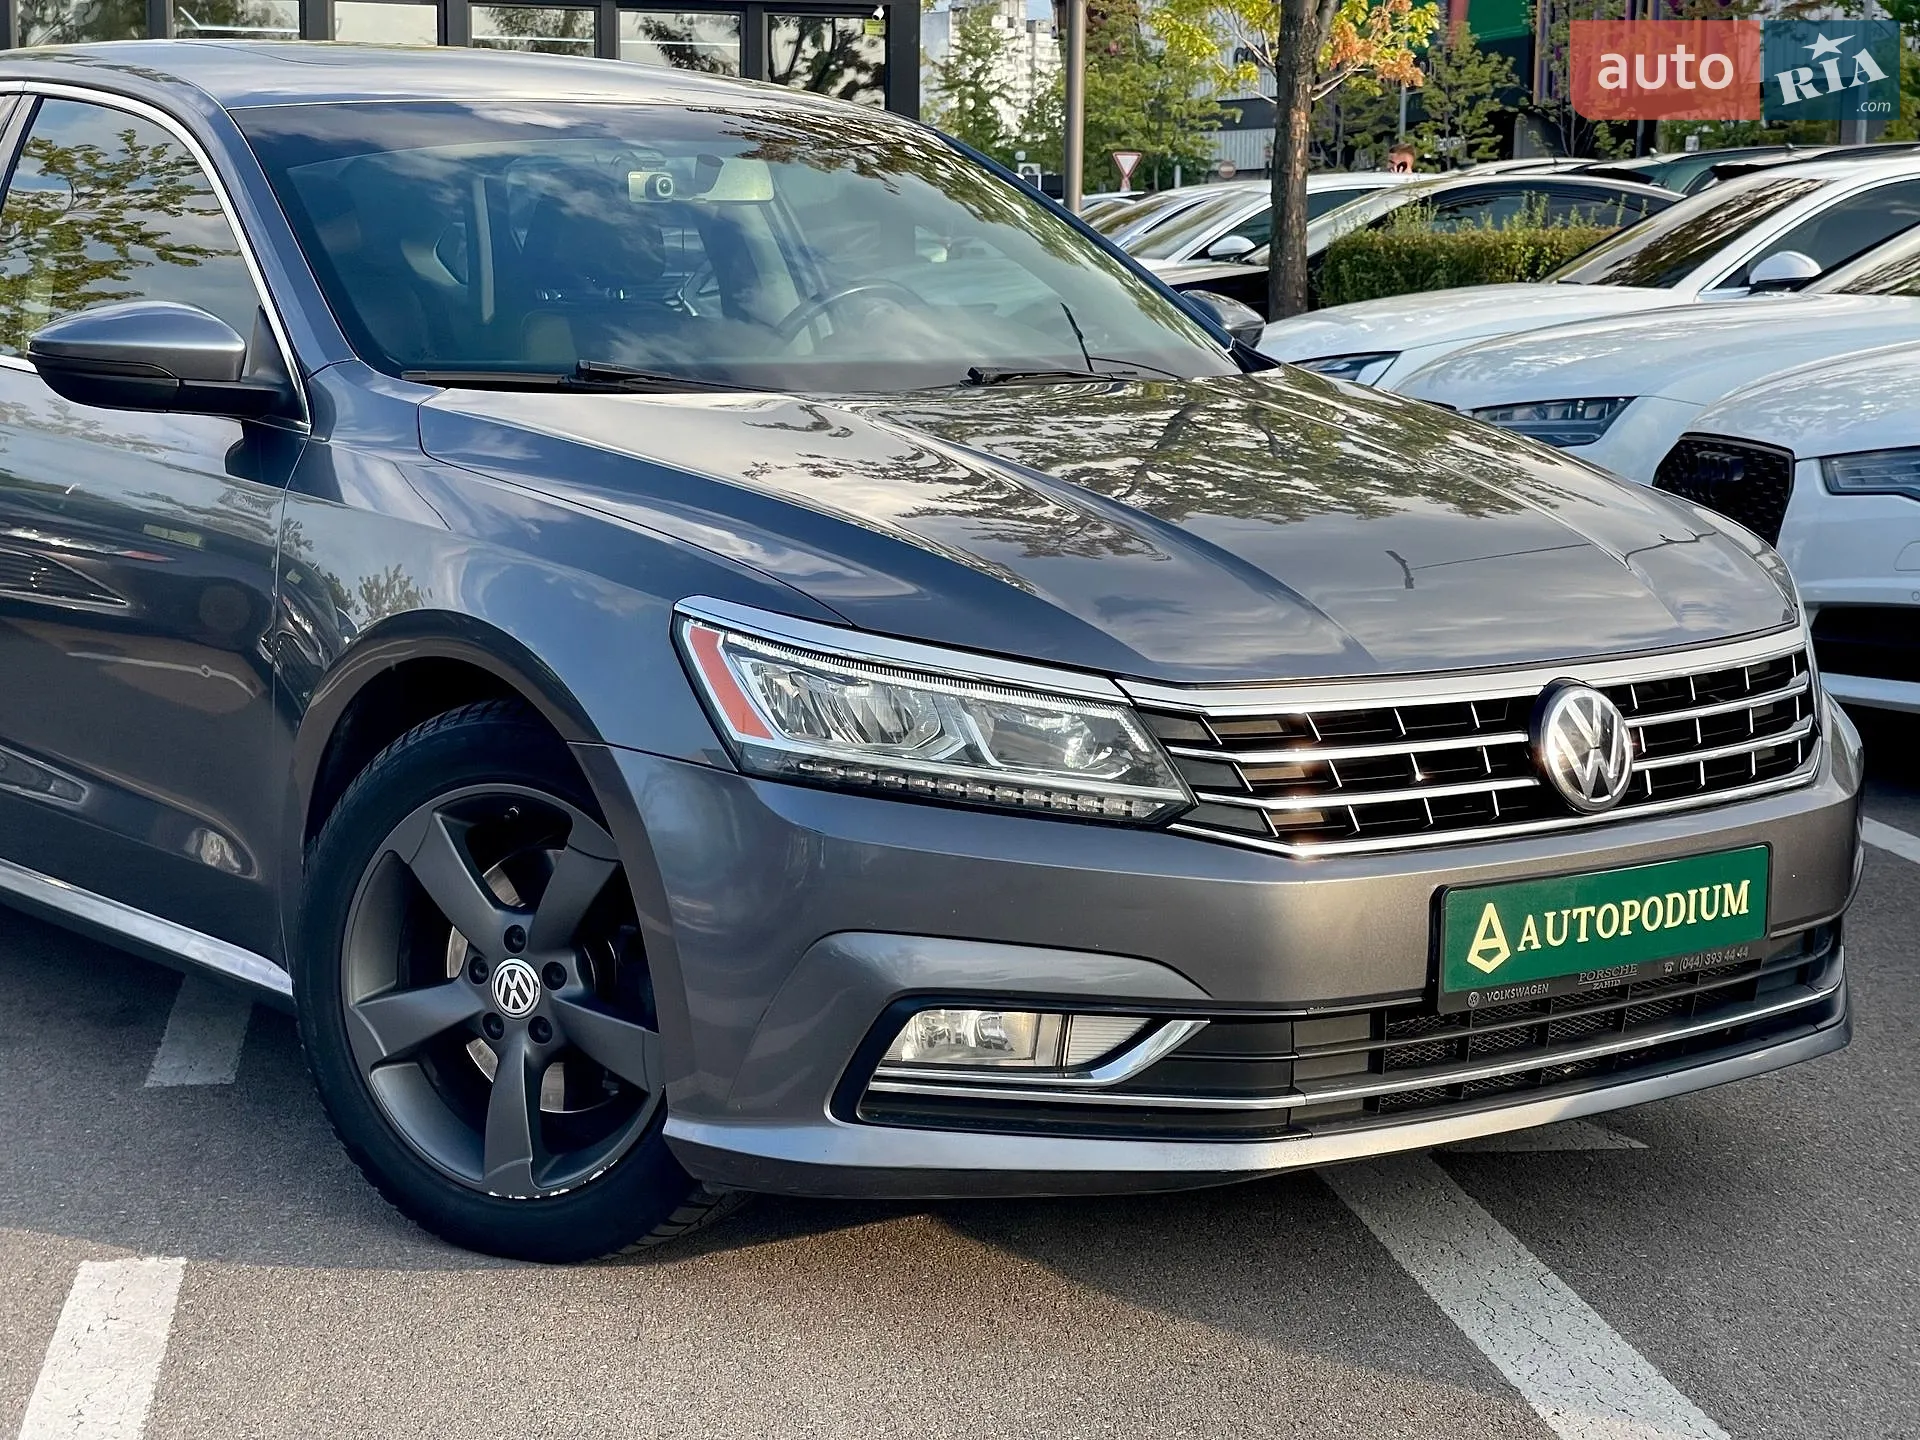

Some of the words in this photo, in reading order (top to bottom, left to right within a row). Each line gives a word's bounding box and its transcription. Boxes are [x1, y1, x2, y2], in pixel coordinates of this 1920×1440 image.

[1517, 879, 1751, 952] AUTOPODIUM
[1679, 953, 1703, 972] (044)
[1578, 963, 1639, 983] PORSCHE
[1486, 983, 1549, 1003] VOLKSWAGEN
